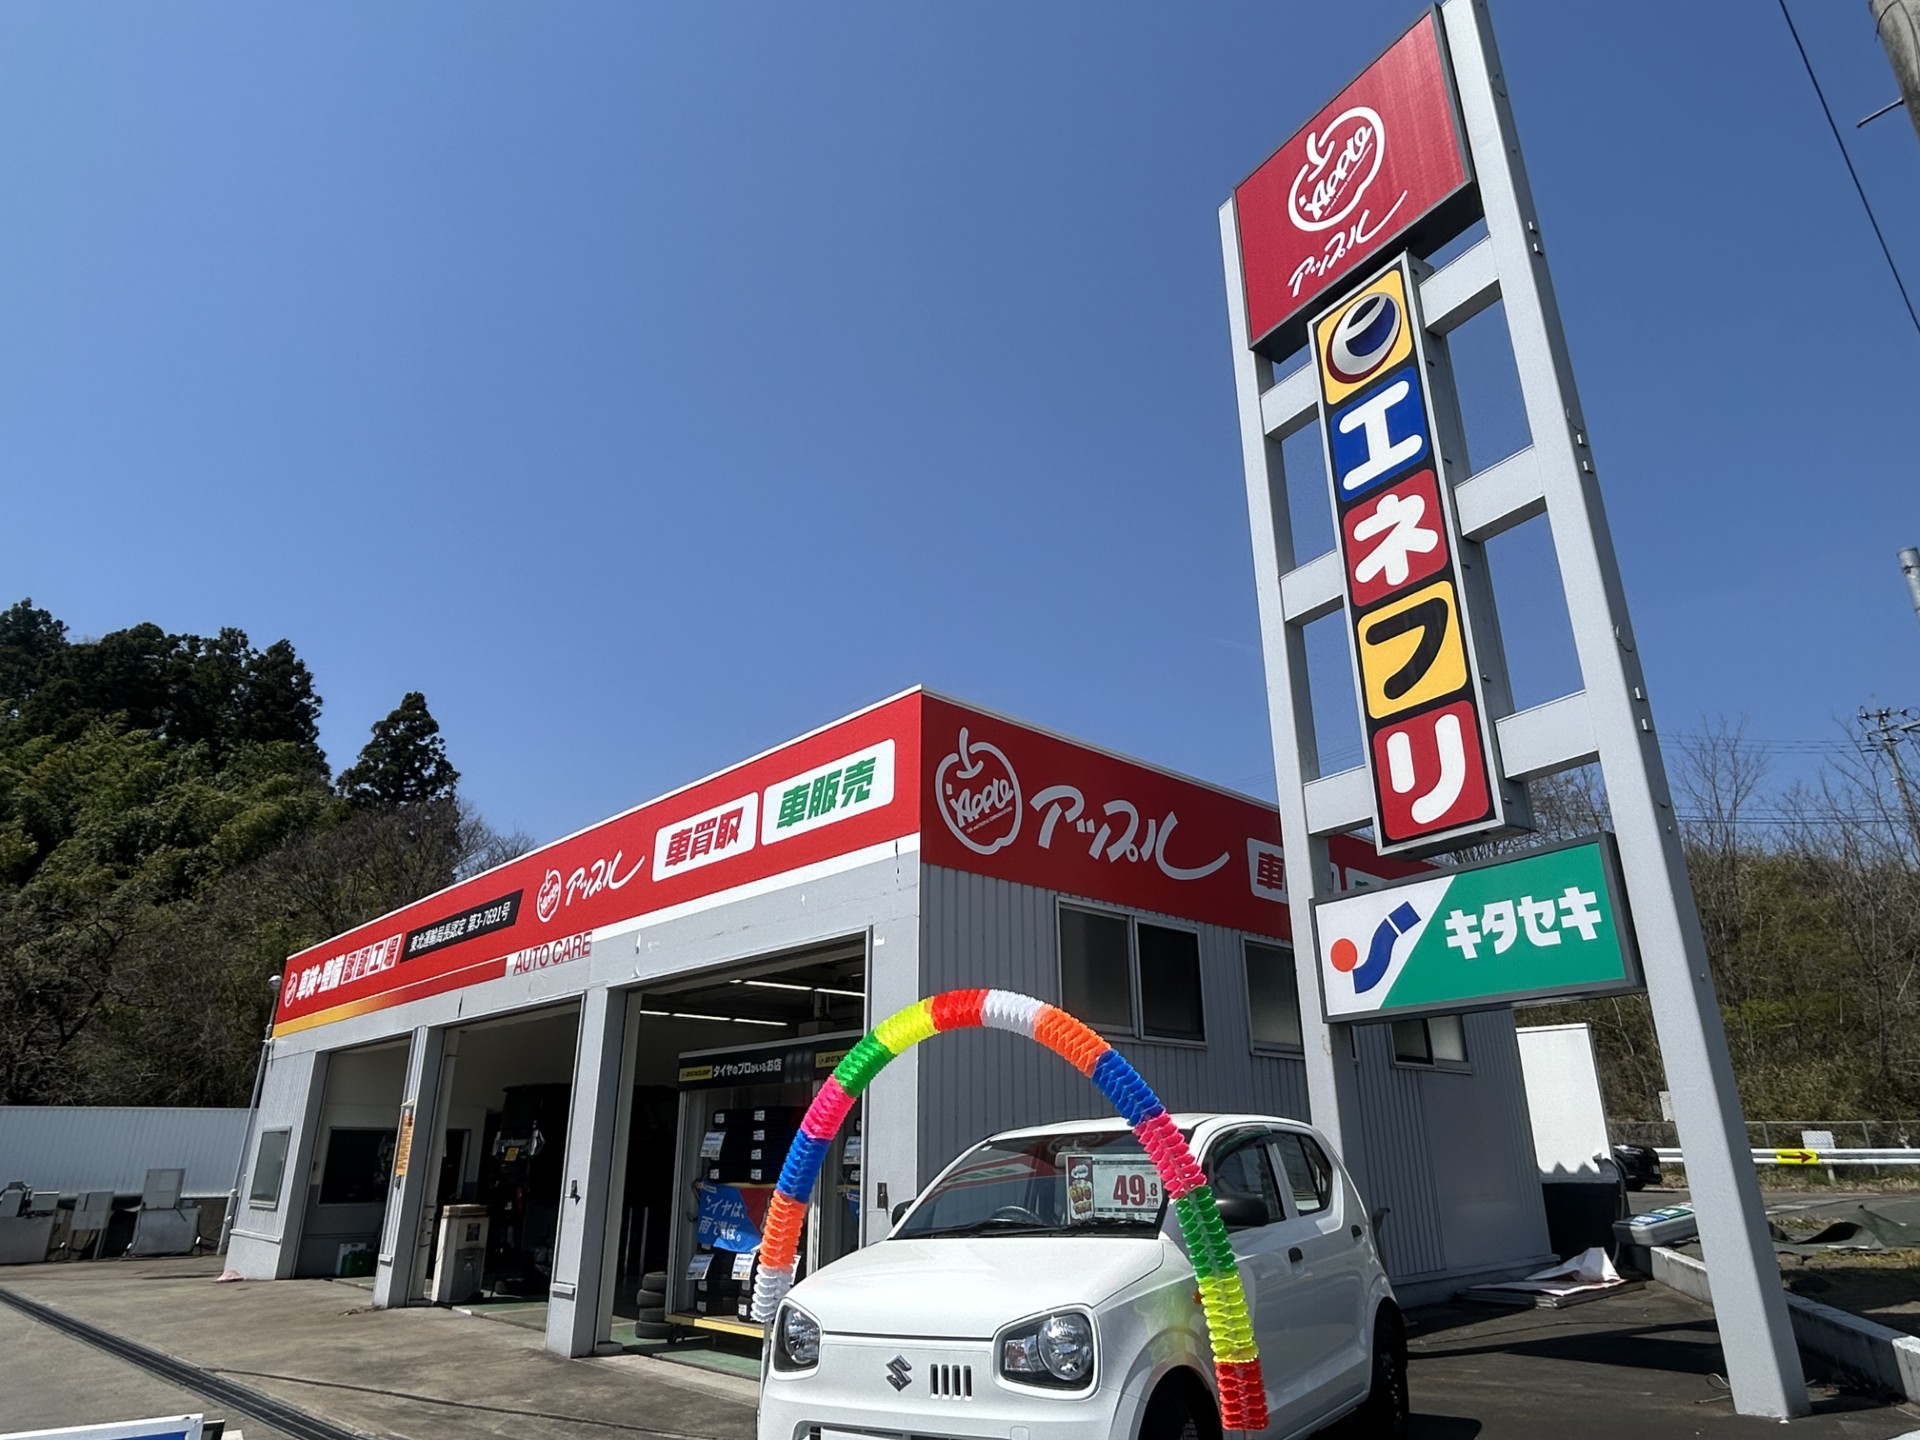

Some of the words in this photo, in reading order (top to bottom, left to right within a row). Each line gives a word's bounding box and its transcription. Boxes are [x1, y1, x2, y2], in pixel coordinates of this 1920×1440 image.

[1287, 190, 1408, 297] アップル
[1340, 380, 1466, 825] エネフリ
[777, 757, 877, 829] 車販売
[664, 806, 745, 868] 車買取
[1030, 784, 1230, 881] アップル
[565, 849, 646, 907] アップル
[513, 943, 550, 975] AUTO
[552, 931, 593, 964] CARE
[1445, 886, 1602, 960] キタセキ
[713, 1058, 782, 1077] タイヤのプロがいるお店
